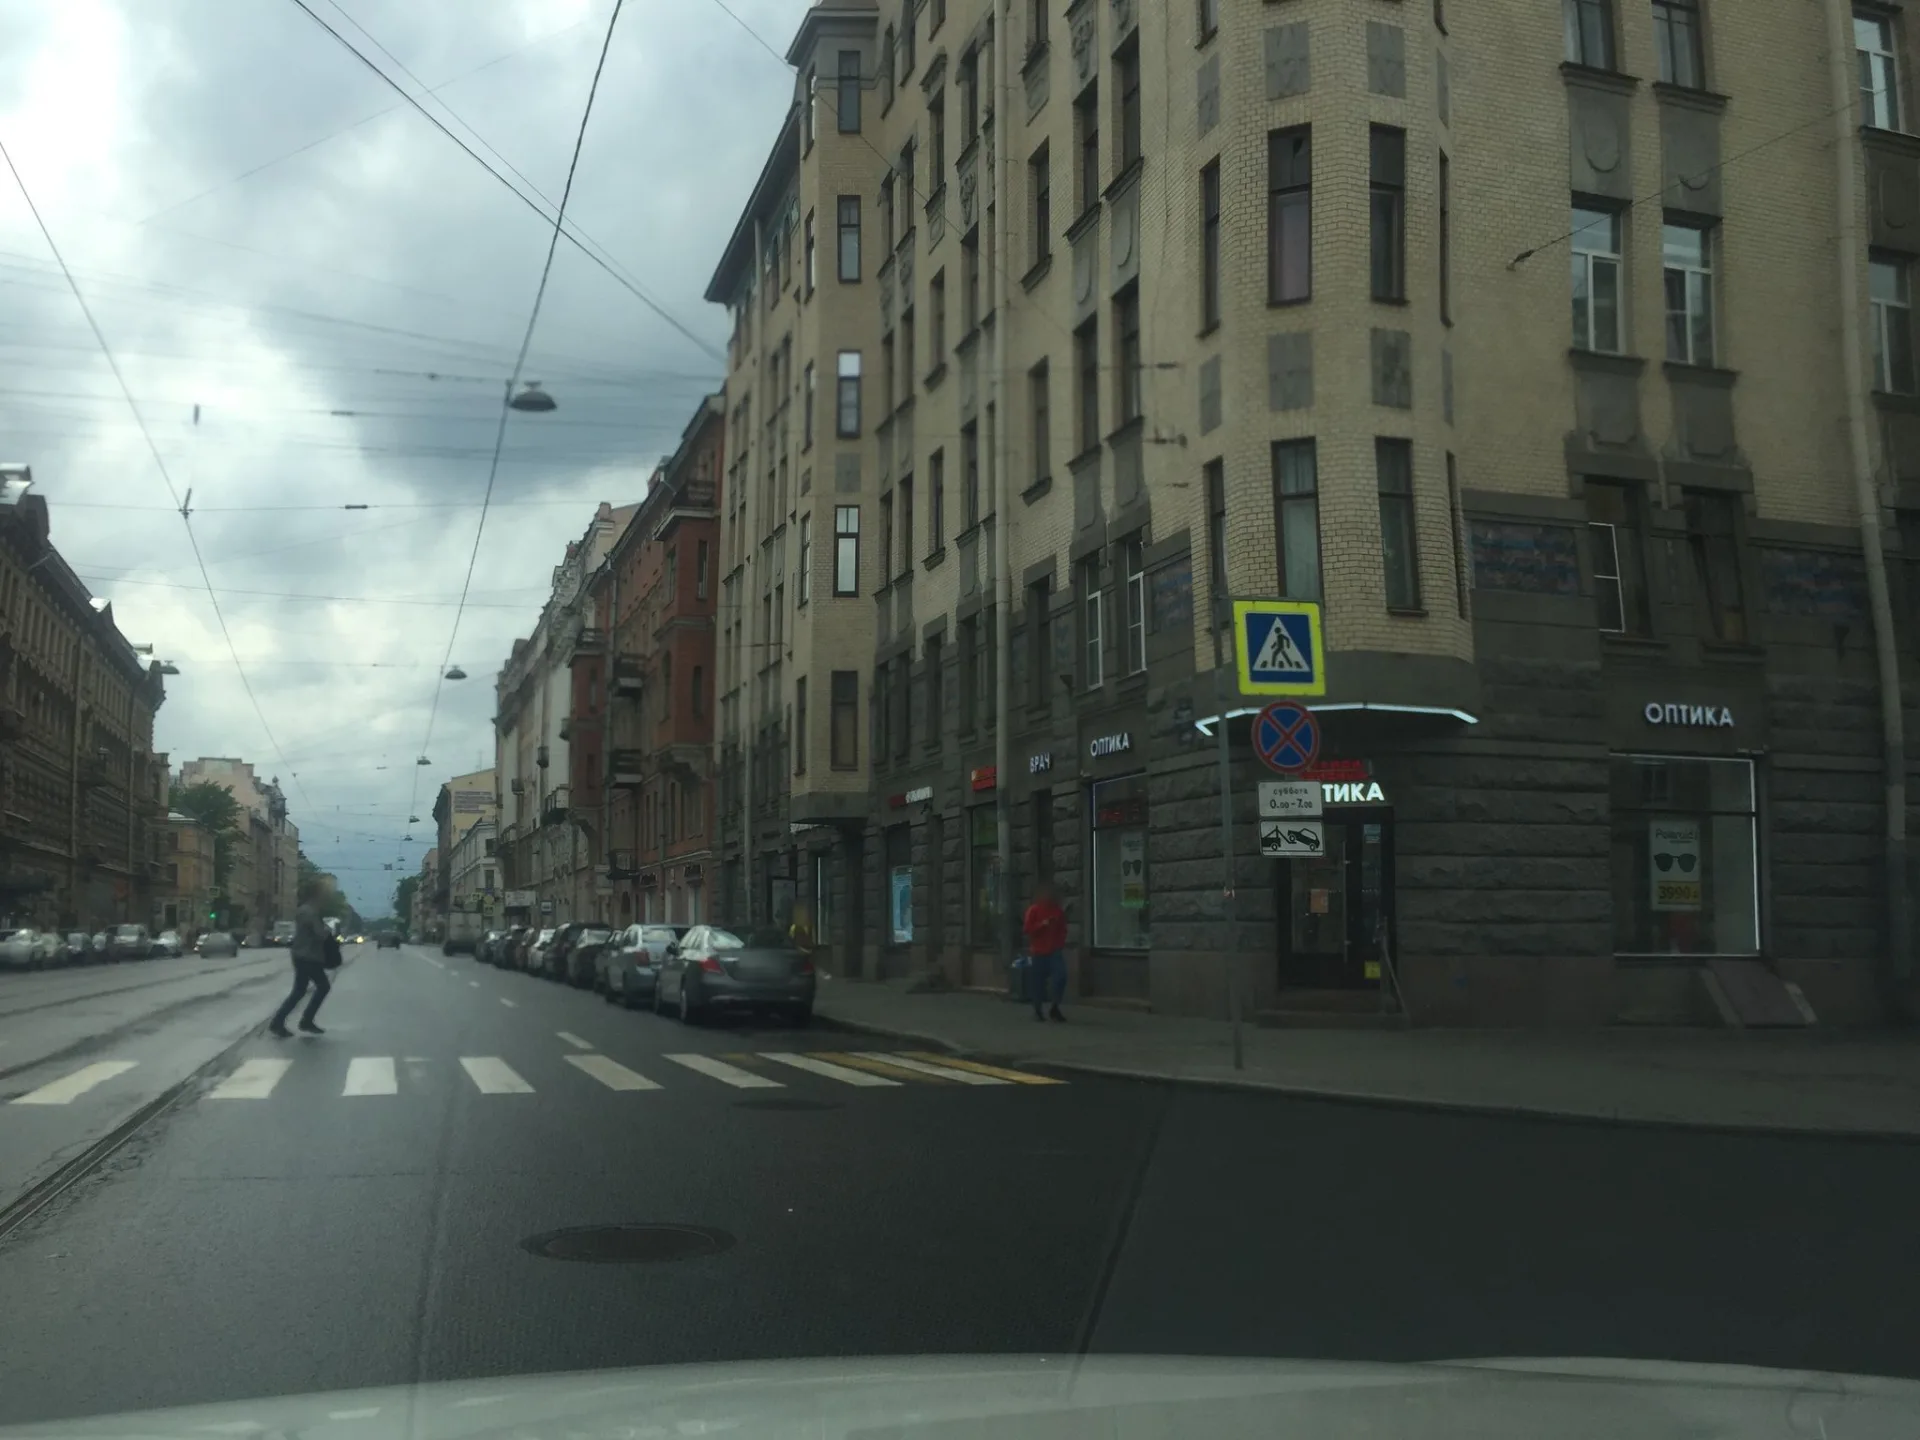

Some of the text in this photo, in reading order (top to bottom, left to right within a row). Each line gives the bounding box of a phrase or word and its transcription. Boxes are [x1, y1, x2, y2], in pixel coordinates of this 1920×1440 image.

[1645, 702, 1734, 728] ОПТИКА
[1090, 732, 1130, 757] ОПТИКА
[1030, 752, 1051, 774] ВРАЧ
[1321, 782, 1385, 803] ТИКА
